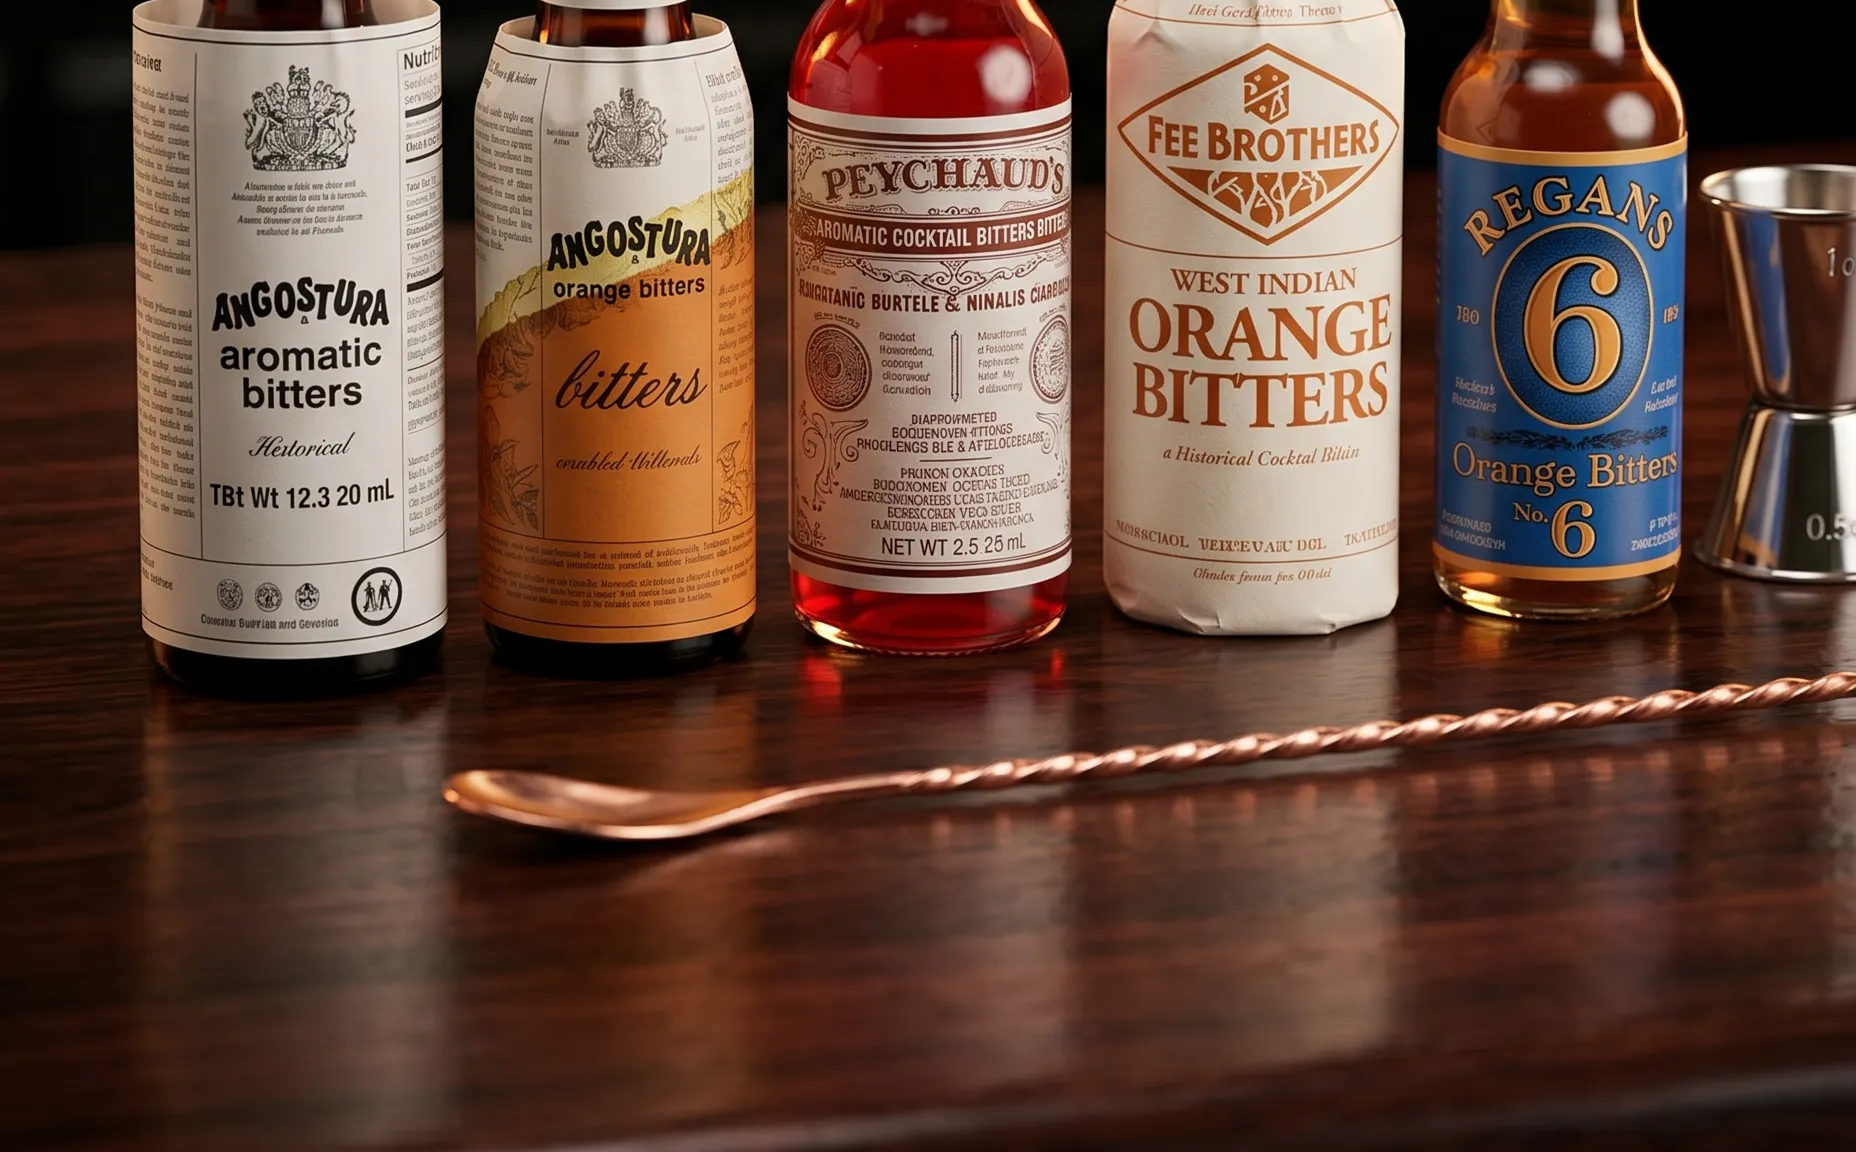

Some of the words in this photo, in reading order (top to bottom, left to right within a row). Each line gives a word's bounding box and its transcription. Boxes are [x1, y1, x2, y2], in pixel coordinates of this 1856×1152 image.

[1148, 115, 1199, 159] FEE
[1207, 119, 1380, 163] BROTHERS
[822, 155, 1065, 201] PEYCHAUD'S
[547, 215, 711, 272] ANGOSTURA
[815, 218, 888, 246] AROMATIC
[892, 227, 972, 248] COCKTAIL
[976, 220, 1035, 246] BITTERS
[211, 276, 390, 332] ANGOSTURA
[553, 281, 632, 305] orange
[639, 277, 706, 299] bitters
[967, 289, 1025, 312] NINALIS
[1170, 268, 1250, 295] WEST
[1257, 267, 1358, 295] INDIAN
[1129, 293, 1393, 362] ORANGE
[1522, 254, 1622, 394] 6
[219, 337, 383, 372] aromatic
[243, 377, 363, 410] bitters
[555, 349, 708, 410] bitters
[1132, 360, 1389, 429] BITTERS
[1163, 449, 1172, 460] a
[1175, 445, 1254, 466] Historical
[1257, 448, 1318, 466] Cocktal
[1453, 442, 1577, 498] Orange
[1587, 450, 1679, 488] Bitters
[209, 482, 245, 508] TBt
[250, 485, 280, 510] Wt
[286, 486, 331, 509] 12.3
[336, 482, 362, 508] 20
[366, 478, 396, 503] mL
[881, 537, 916, 556] NET
[920, 538, 948, 556] WT
[953, 537, 979, 556] 2.5
[984, 534, 1004, 554] 25
[1007, 532, 1027, 551] mL
[1512, 501, 1549, 524] No.
[1551, 499, 1597, 559] 6
